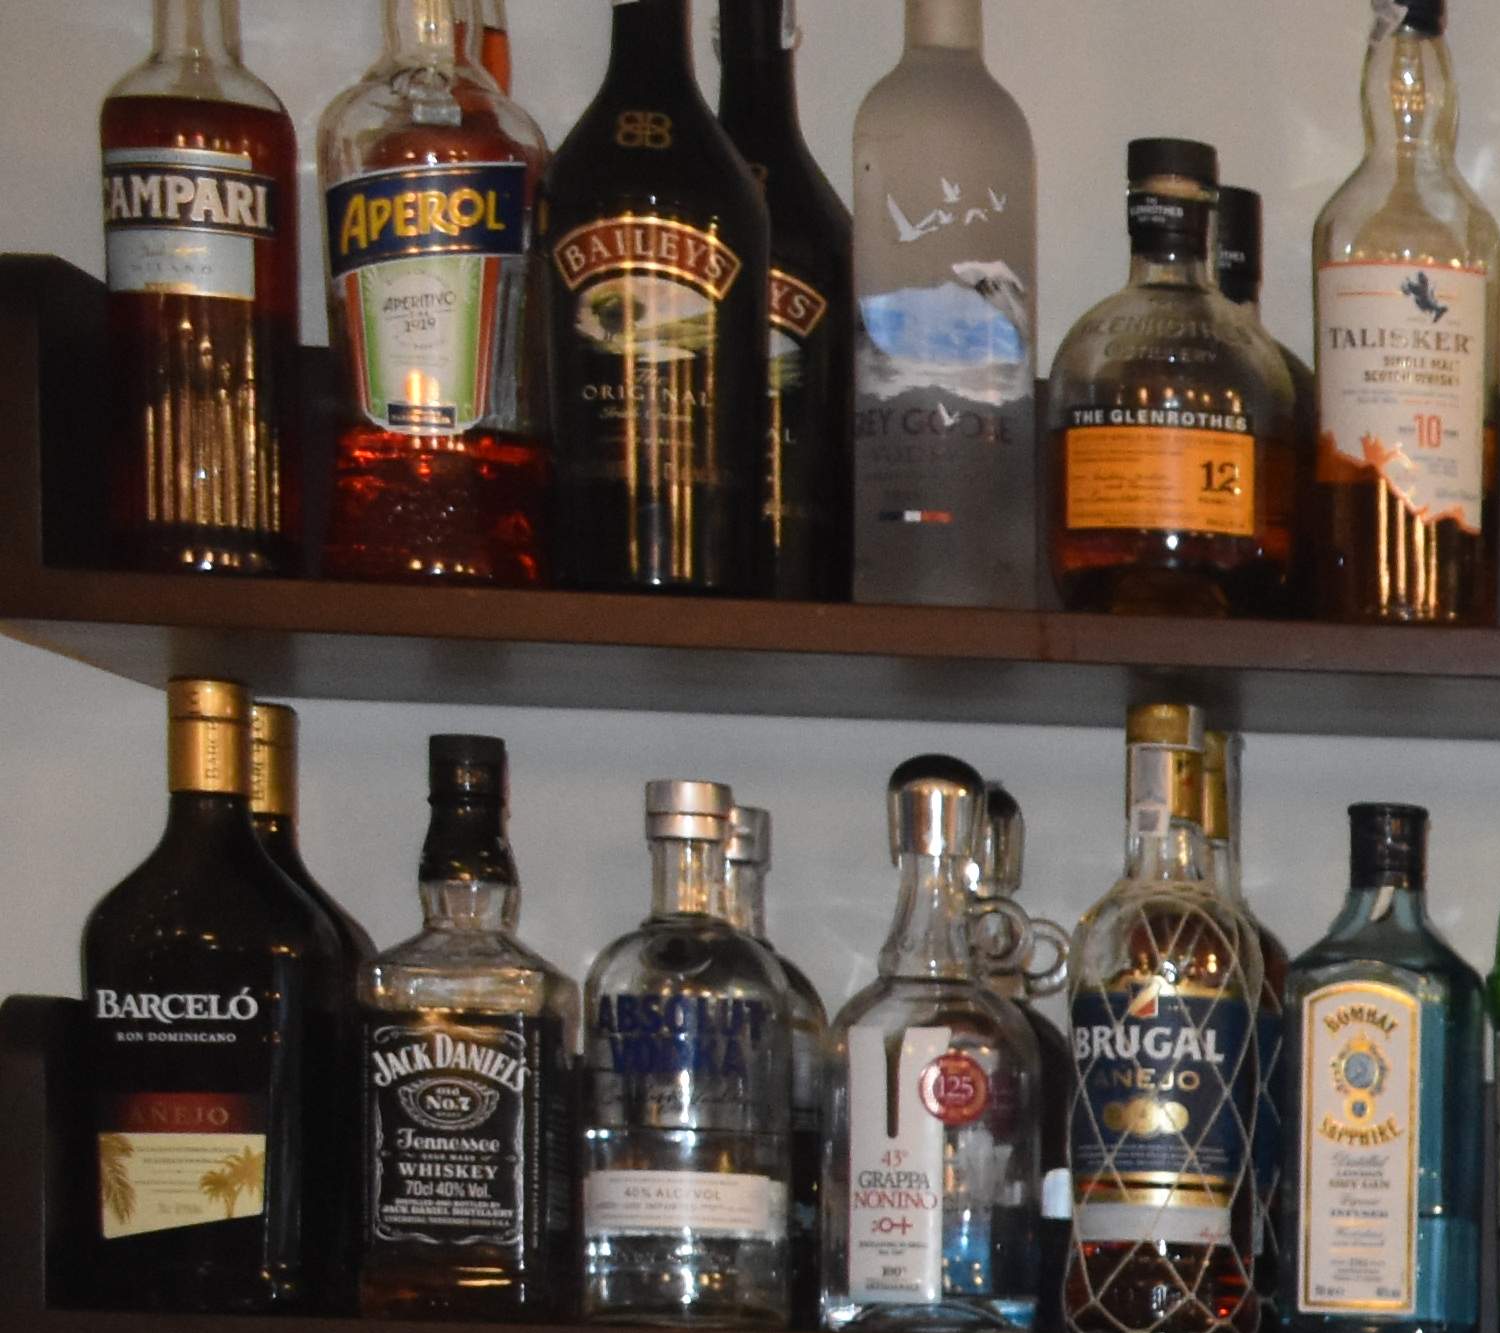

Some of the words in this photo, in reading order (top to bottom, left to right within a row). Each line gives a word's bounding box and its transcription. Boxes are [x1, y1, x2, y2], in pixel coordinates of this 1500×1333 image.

[341, 187, 506, 256] APEROL
[564, 229, 727, 278] BAILEYS
[1329, 327, 1471, 355] TALISKER
[582, 383, 714, 408] ORIGINAL
[1073, 410, 1104, 425] THE
[1110, 408, 1247, 432] GLENROTHES
[1414, 414, 1442, 449] 10
[1200, 460, 1240, 492] 12
[96, 986, 259, 1024] BARCELÓ
[1323, 1004, 1398, 1034] BOMBAY
[116, 1031, 144, 1042] RON
[148, 1031, 237, 1043] DOMINICANO
[1074, 1024, 1225, 1063] BRUGAL
[372, 1042, 433, 1087] JACK
[434, 1033, 532, 1092] DANIEL'S
[939, 1074, 975, 1100] 125
[397, 1127, 500, 1152] Tennessee
[397, 1162, 499, 1179] WHISKEY
[858, 1170, 931, 1189] GRAPPA
[405, 1180, 434, 1196] 70cl
[435, 1182, 466, 1196] 40%
[853, 1191, 939, 1210] NONINO
